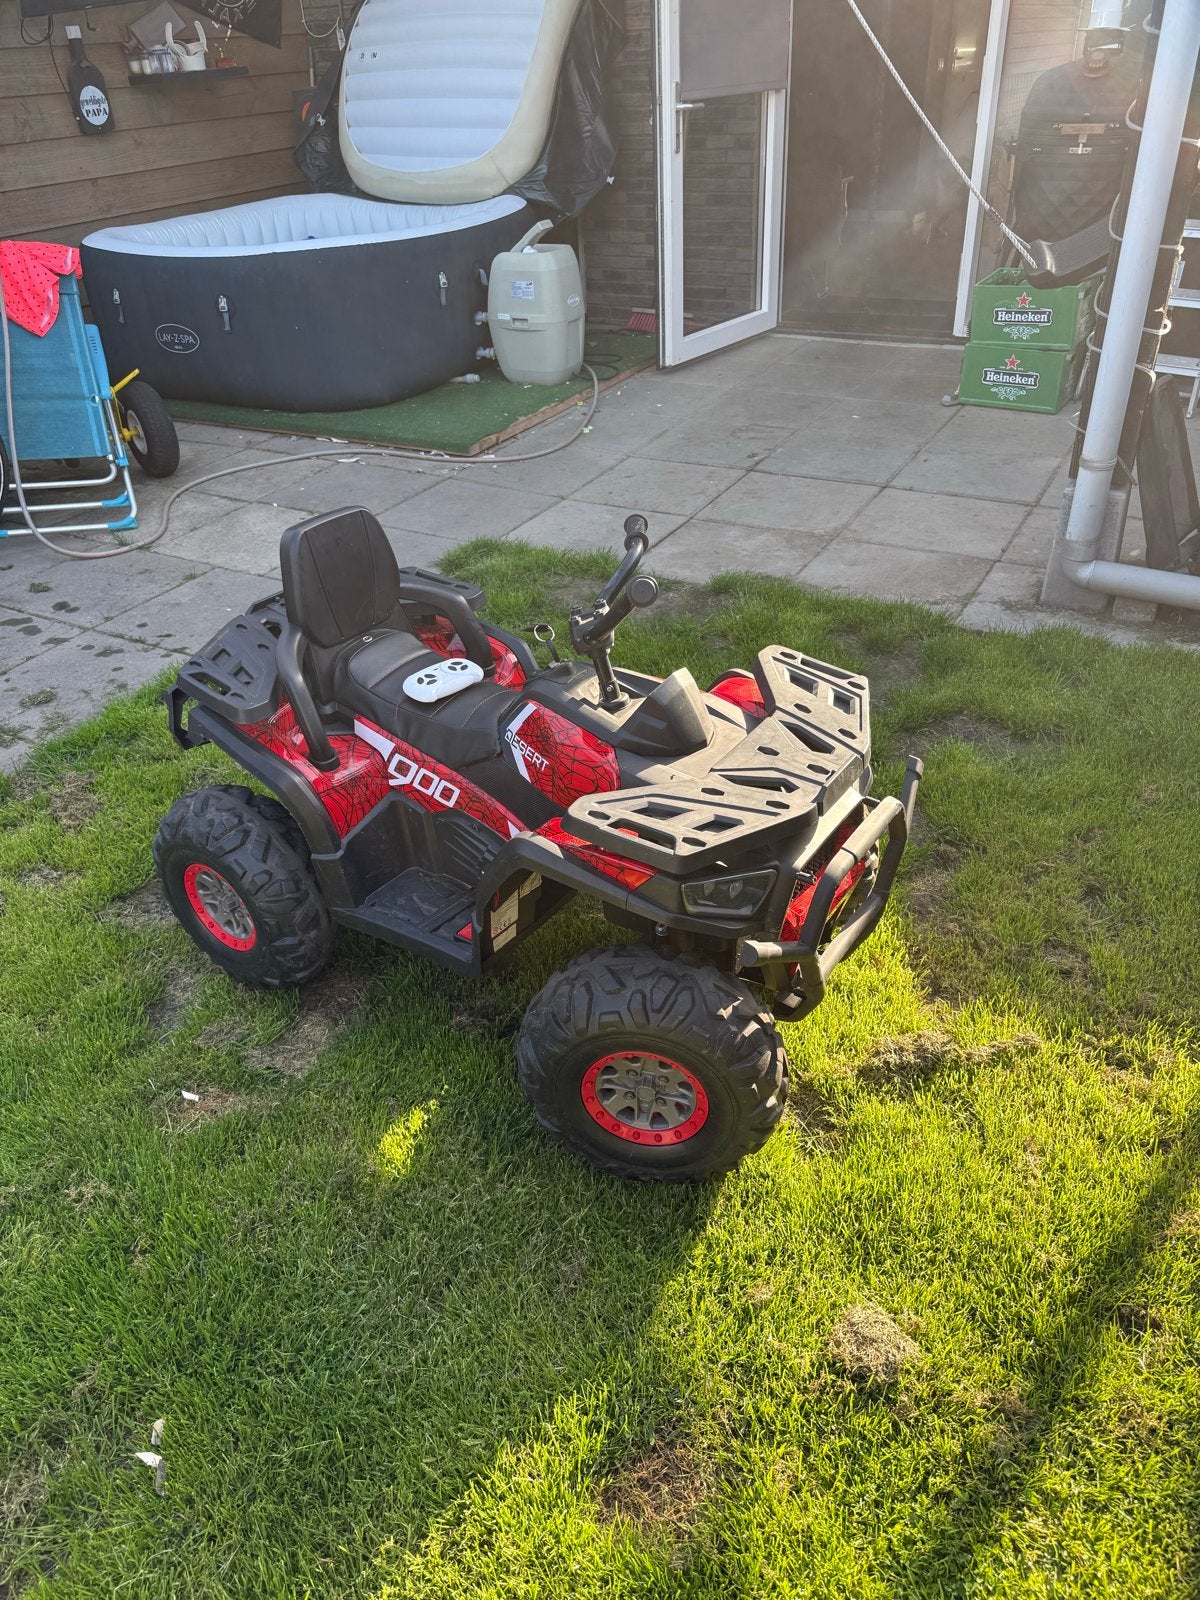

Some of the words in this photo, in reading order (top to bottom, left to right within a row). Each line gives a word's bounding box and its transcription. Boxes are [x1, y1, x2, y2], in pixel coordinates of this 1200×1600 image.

[85, 107, 108, 118] PAPA
[997, 311, 1048, 322] Heineken
[158, 333, 196, 344] LAY-Z-SPA
[986, 371, 1035, 385] Heineken
[504, 728, 550, 772] DESERT
[387, 753, 461, 808] 900
